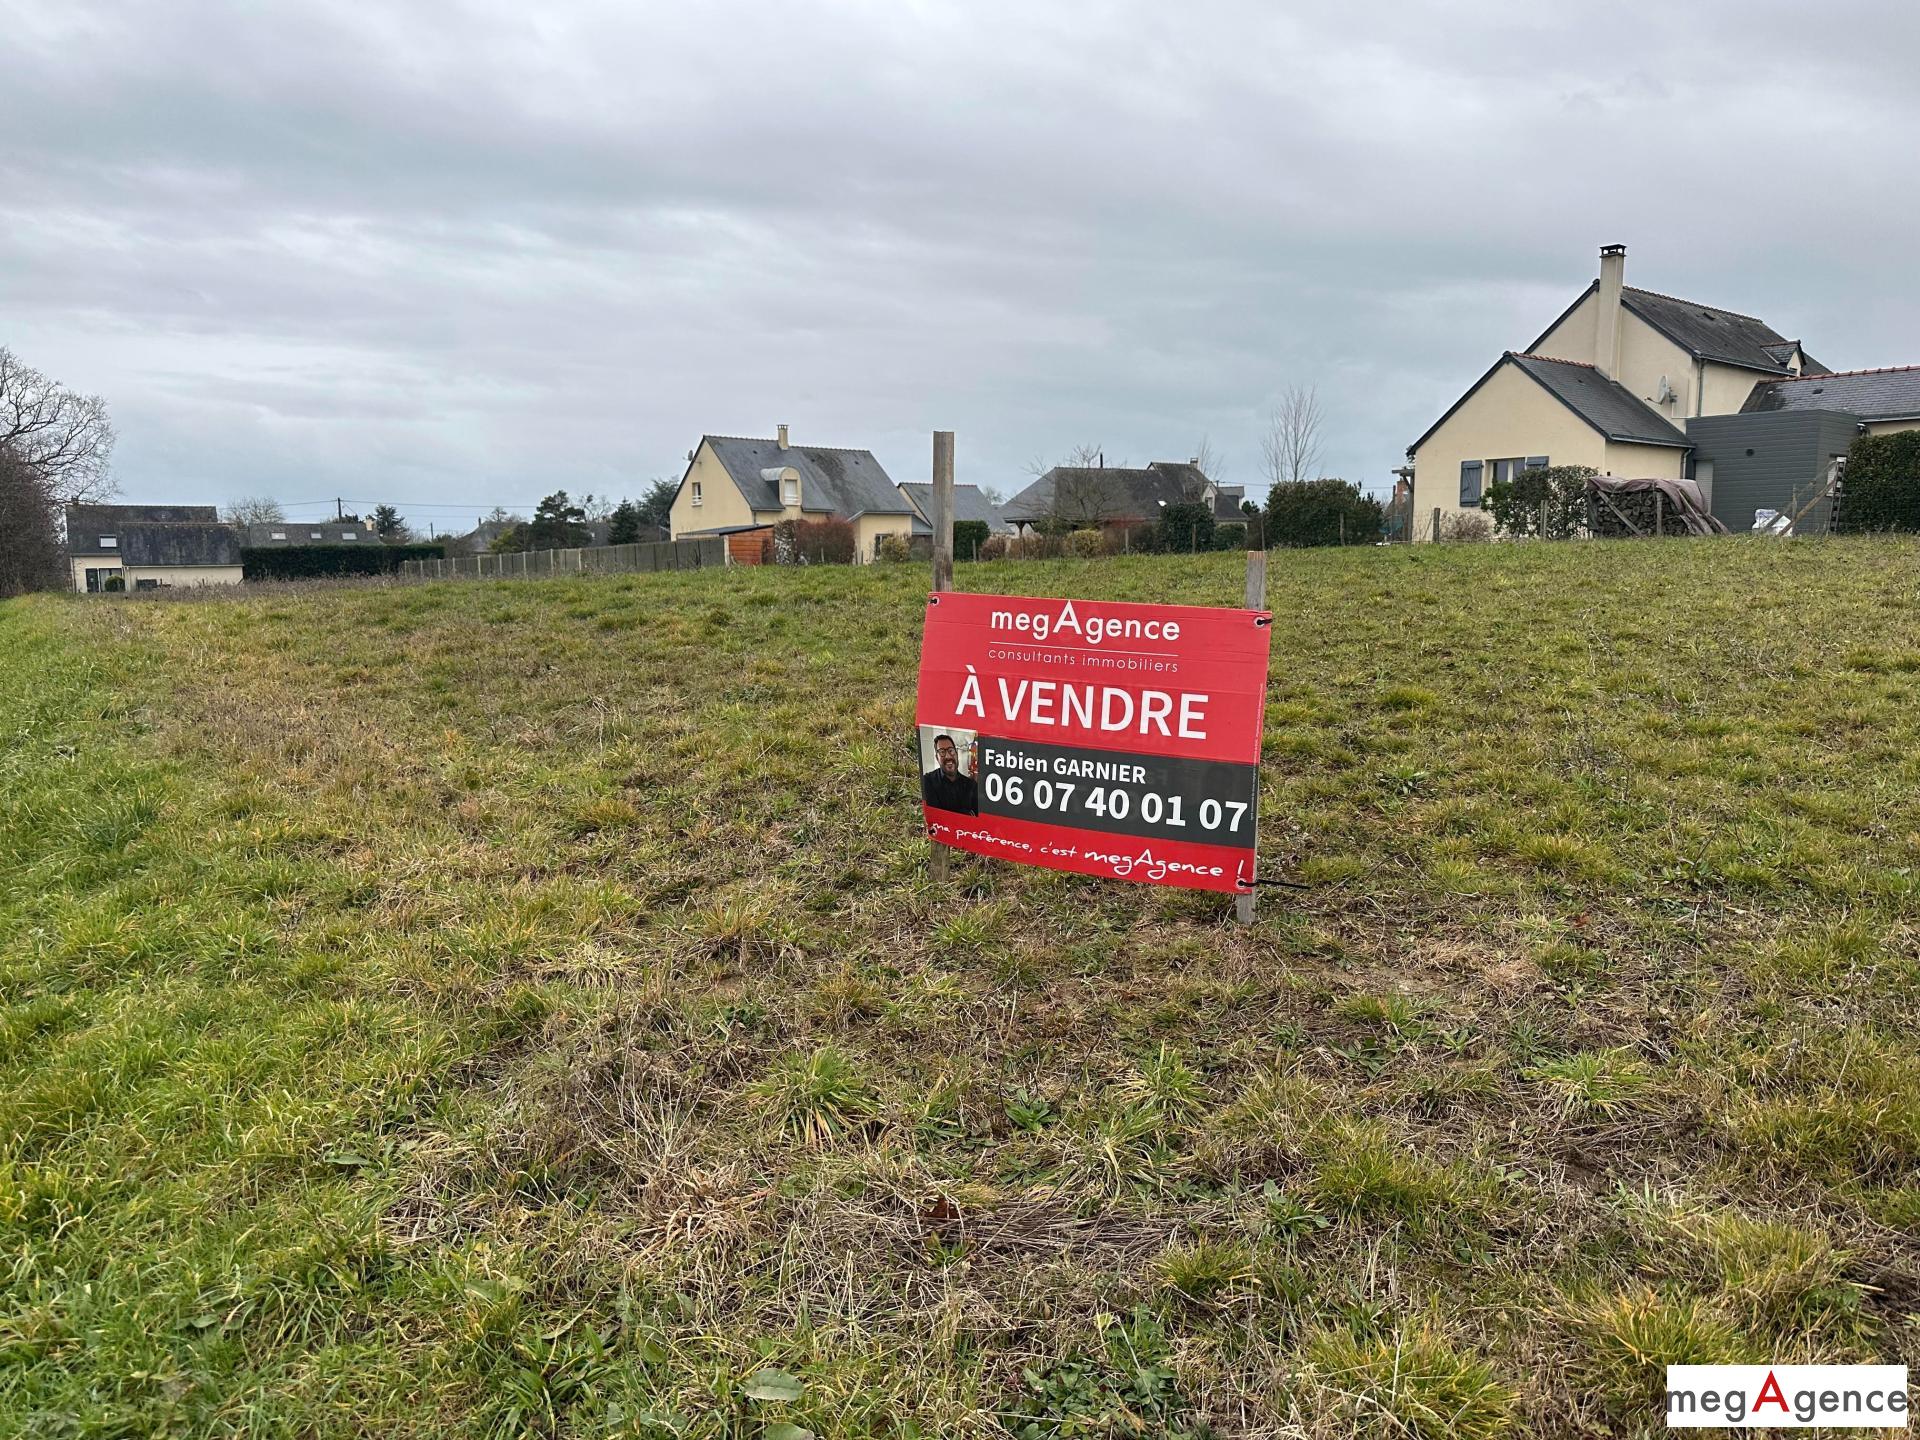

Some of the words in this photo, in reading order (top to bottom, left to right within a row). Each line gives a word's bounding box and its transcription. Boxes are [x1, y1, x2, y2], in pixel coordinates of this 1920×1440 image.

[991, 600, 1180, 644] megAgence
[988, 648, 1076, 666] consultants
[1082, 654, 1178, 673] immobiliers
[955, 664, 985, 718] À
[998, 677, 1209, 740] VENDRE
[985, 749, 1048, 773] Fabien
[1053, 757, 1146, 784] GARNIER
[985, 773, 1024, 806] 06
[1033, 779, 1076, 812] 07
[1084, 786, 1130, 820] 40
[1141, 792, 1186, 827] 01
[1199, 799, 1247, 832] 07
[955, 829, 1033, 852] préférence,
[1040, 841, 1077, 857] c'est
[1084, 848, 1223, 880] megAgence
